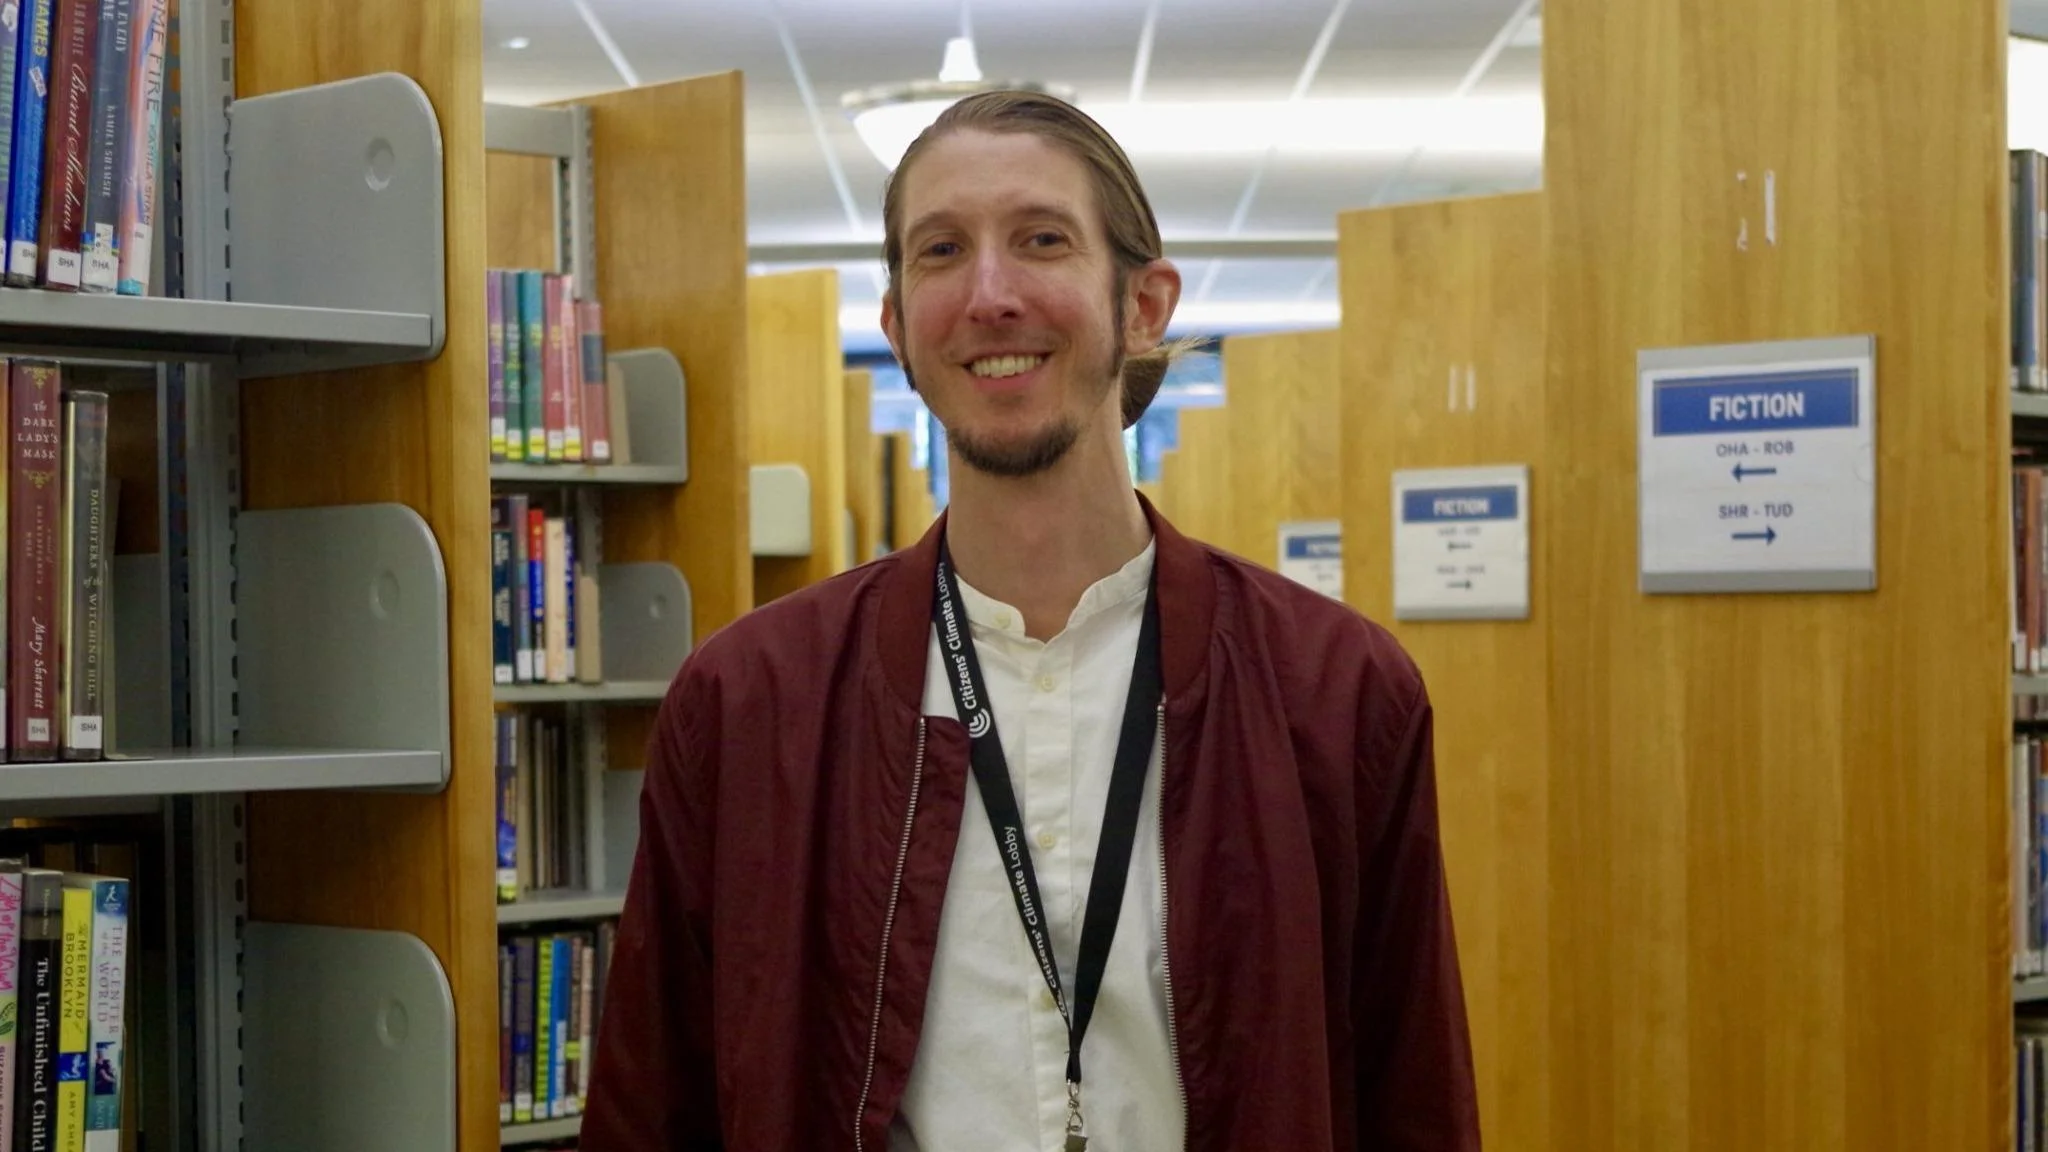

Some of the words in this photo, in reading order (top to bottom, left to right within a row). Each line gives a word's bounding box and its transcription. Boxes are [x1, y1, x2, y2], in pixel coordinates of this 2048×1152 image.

[34, 0, 49, 56] AMES
[72, 2, 87, 56] SHAMSIE
[69, 63, 87, 132] Burnt
[146, 52, 161, 112] FIRE
[104, 105, 117, 147] KAMILA
[63, 137, 84, 232] Shadows
[101, 150, 115, 198] SHAMSIE
[58, 257, 75, 268] SHA
[92, 260, 110, 270] SHA
[22, 418, 56, 428] DARK
[33, 400, 47, 412] The
[1709, 391, 1804, 421] FICTION
[17, 433, 58, 444] LADY'S
[22, 449, 56, 460] MASK
[1716, 443, 1748, 457] OHA
[1763, 440, 1794, 455] ROB
[1433, 497, 1490, 515] FICTION
[1718, 504, 1748, 519] SHR
[1764, 503, 1793, 517] TUD
[89, 489, 99, 569] DAUGHTERS
[936, 562, 950, 600] Lobby
[29, 616, 46, 655] Mary
[88, 594, 98, 664] WITCHING
[941, 600, 962, 651] Climate
[33, 659, 48, 710] Sharratt
[87, 669, 96, 701] HILL
[80, 722, 97, 733] SHA
[1003, 825, 1022, 869] Lobby
[1015, 869, 1039, 926] Climate
[111, 925, 122, 957] THE
[36, 957, 49, 986] The
[64, 932, 76, 1019] BROOKLYN
[76, 940, 87, 1020] MERMAID
[97, 961, 110, 1024] WORLD
[109, 967, 122, 1035] CENTER
[33, 991, 51, 1094] Unfinished
[31, 1099, 47, 1152] Child
[69, 1091, 77, 1118] AMY
[66, 1124, 76, 1152] SHE
